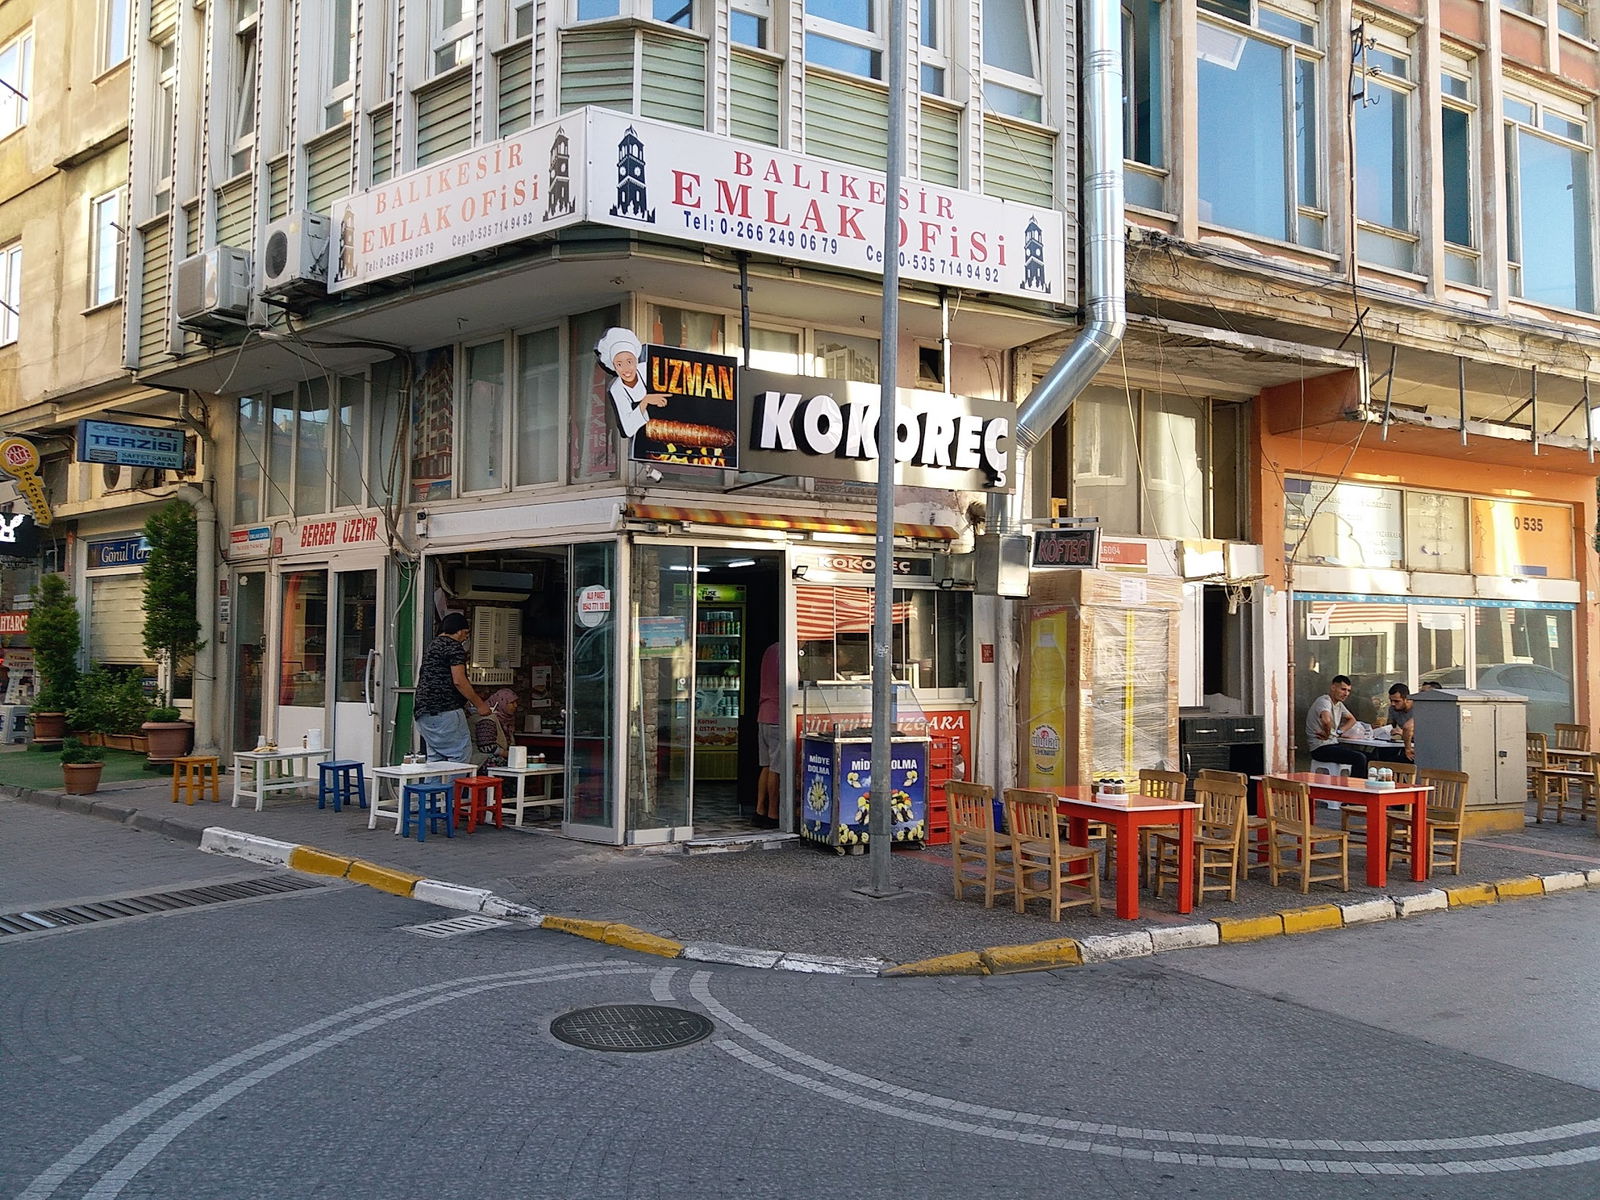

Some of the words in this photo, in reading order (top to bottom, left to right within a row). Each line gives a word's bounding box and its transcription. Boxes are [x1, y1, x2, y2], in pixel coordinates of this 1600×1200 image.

[375, 142, 524, 216] BALIKESİR
[734, 150, 954, 219] BALIKESİR
[494, 220, 509, 234] 714
[511, 215, 521, 230] 94
[522, 211, 533, 226] 92
[671, 169, 866, 241] EMLAK
[361, 203, 452, 255] EMLAK
[769, 227, 795, 247] 249
[800, 233, 817, 251] 06
[821, 237, 838, 255] 79
[940, 258, 962, 277] 714
[966, 263, 981, 280] 94
[985, 266, 999, 283] 92
[651, 355, 734, 401] UZMAN
[756, 389, 1009, 488] KOKOREÇ
[300, 521, 337, 548] BERBER
[1514, 516, 1521, 531] 0
[1523, 517, 1544, 532] 535
[101, 541, 129, 563] Gönül
[807, 764, 831, 776] DOLMA
[808, 754, 831, 766] MİDYE
[851, 757, 873, 771] MİD
[890, 759, 918, 770] OLMA
